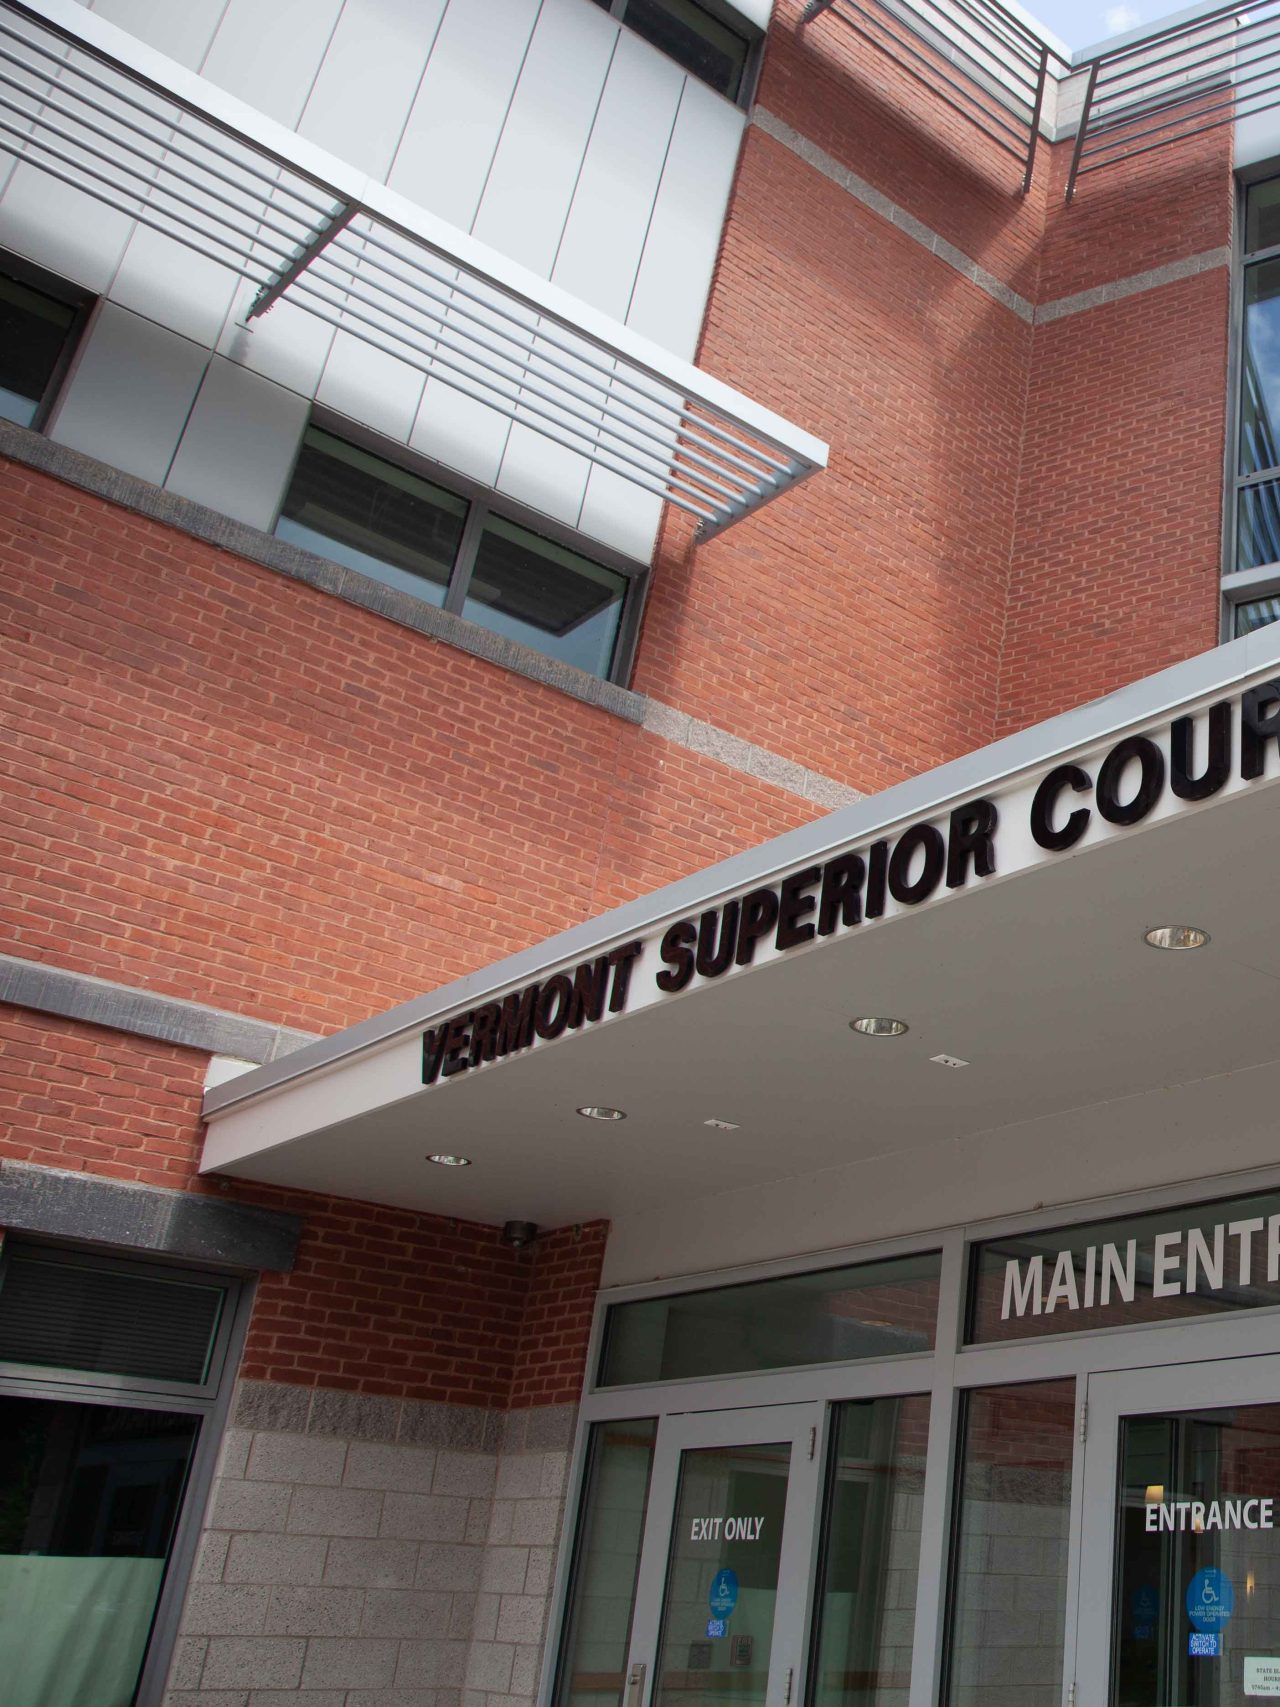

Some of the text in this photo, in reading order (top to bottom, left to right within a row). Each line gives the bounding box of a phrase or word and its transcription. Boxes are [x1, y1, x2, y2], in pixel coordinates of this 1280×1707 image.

[422, 941, 642, 1085] VERMONT
[656, 800, 998, 994] SUPERIOR
[1000, 1238, 1137, 1320] MAIN
[1145, 1498, 1274, 1532] ENTRANCE
[690, 1516, 764, 1541] EXIT ONLY
[1190, 1640, 1217, 1648] SWITCH TO
[1192, 1633, 1215, 1641] ACTIVATE
[1191, 1647, 1215, 1655] OPERATE
